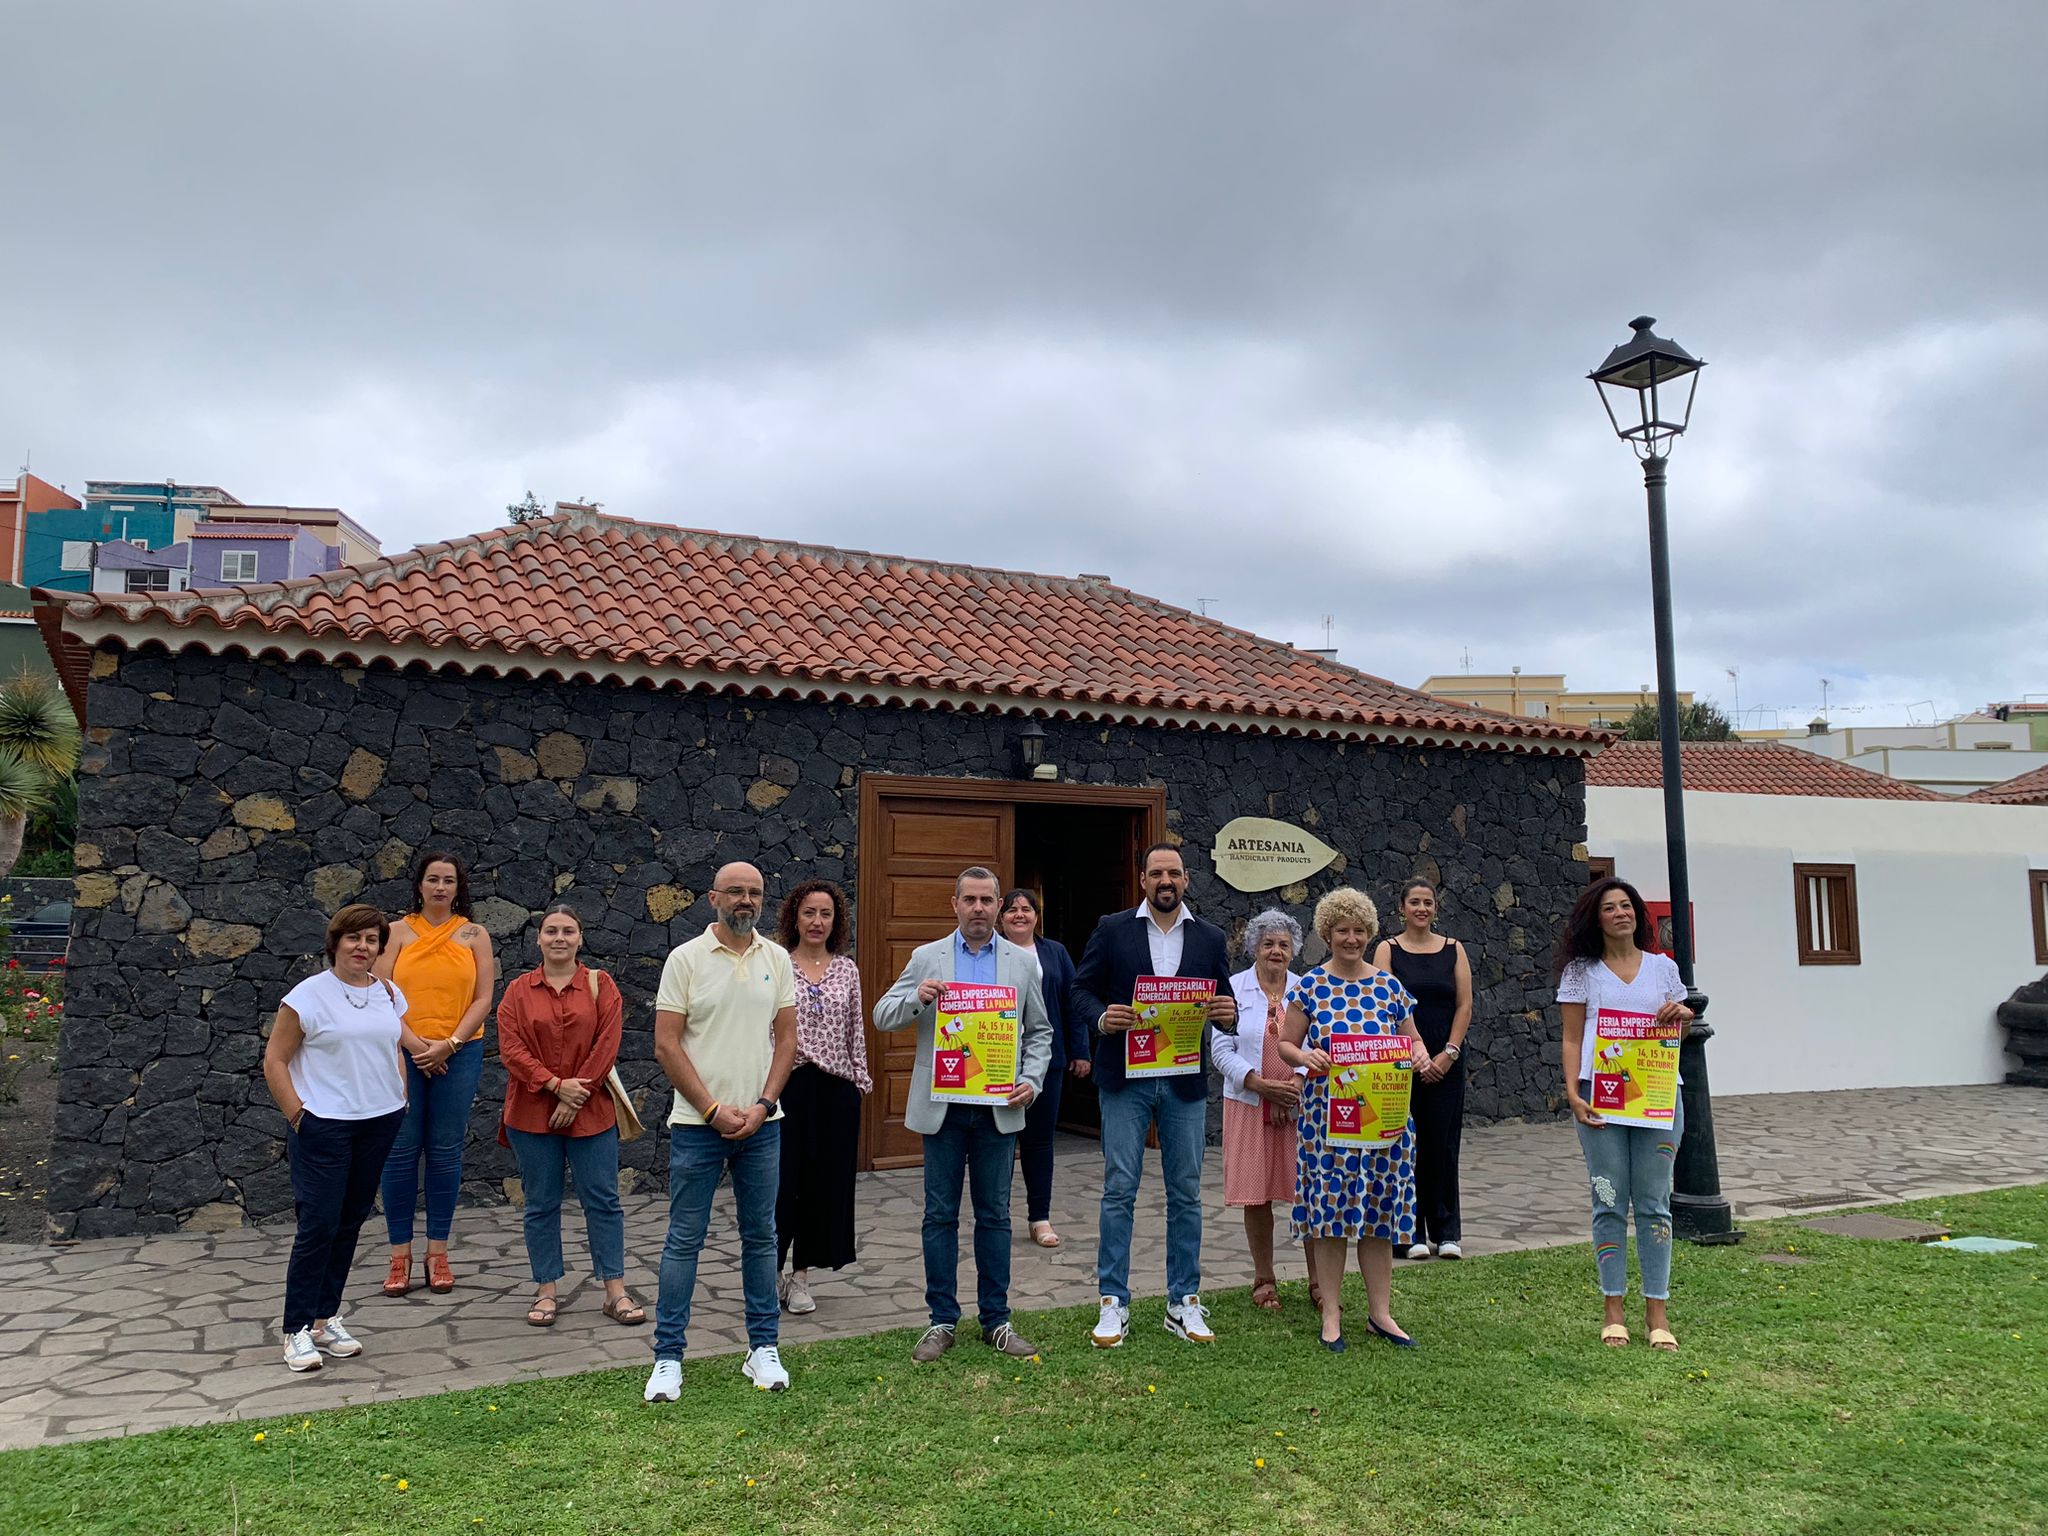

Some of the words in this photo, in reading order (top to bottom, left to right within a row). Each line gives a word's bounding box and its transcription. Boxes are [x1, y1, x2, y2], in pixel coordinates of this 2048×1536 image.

[1228, 839, 1305, 853] ARTESANIA
[1230, 854, 1274, 862] HANDICRAFT
[1277, 856, 1311, 864] PRODUCTS
[1137, 982, 1158, 992] FERIA
[1159, 981, 1206, 991] EMPRESARIAL
[1208, 981, 1213, 990] Y
[962, 989, 1008, 999] EMPRESARIAL
[1008, 989, 1013, 998] Y
[1137, 992, 1171, 1001] COMERCIAL
[1173, 992, 1181, 1000] DE
[1182, 991, 1190, 1000] LA
[940, 1001, 975, 1011] COMERCIAL
[976, 1000, 984, 1009] DE
[985, 1000, 994, 1008] LA
[995, 999, 1015, 1008] PALMA
[978, 1022, 988, 1031] 14,
[991, 1022, 997, 1031] 15
[1006, 1023, 1014, 1031] 16
[1599, 1017, 1620, 1026] FERIA
[977, 1032, 985, 1040] DE
[987, 1033, 1014, 1041] OCTUBRE
[1599, 1028, 1635, 1037] COMERCIAL
[1636, 1028, 1645, 1037] DE
[1646, 1028, 1655, 1037] LA
[1655, 1028, 1678, 1037] PALMA
[1332, 1041, 1353, 1053] FERIA
[1354, 1038, 1402, 1051] EMPRESARIAL
[1402, 1038, 1407, 1048] Y
[1333, 1052, 1368, 1063] COMERCIAL
[1370, 1051, 1378, 1061] DE
[1379, 1051, 1388, 1060] LA
[1389, 1049, 1410, 1059] PALMA
[1638, 1048, 1648, 1058] 14,
[1650, 1049, 1658, 1058] 15
[1660, 1050, 1665, 1058] Y
[1668, 1051, 1675, 1060] 16
[1637, 1058, 1645, 1066] DE
[1647, 1060, 1674, 1069] OCTUBRE
[1373, 1072, 1382, 1082] 14,
[1385, 1073, 1392, 1081] 15
[1395, 1073, 1400, 1081] Y
[1402, 1073, 1408, 1081] 16
